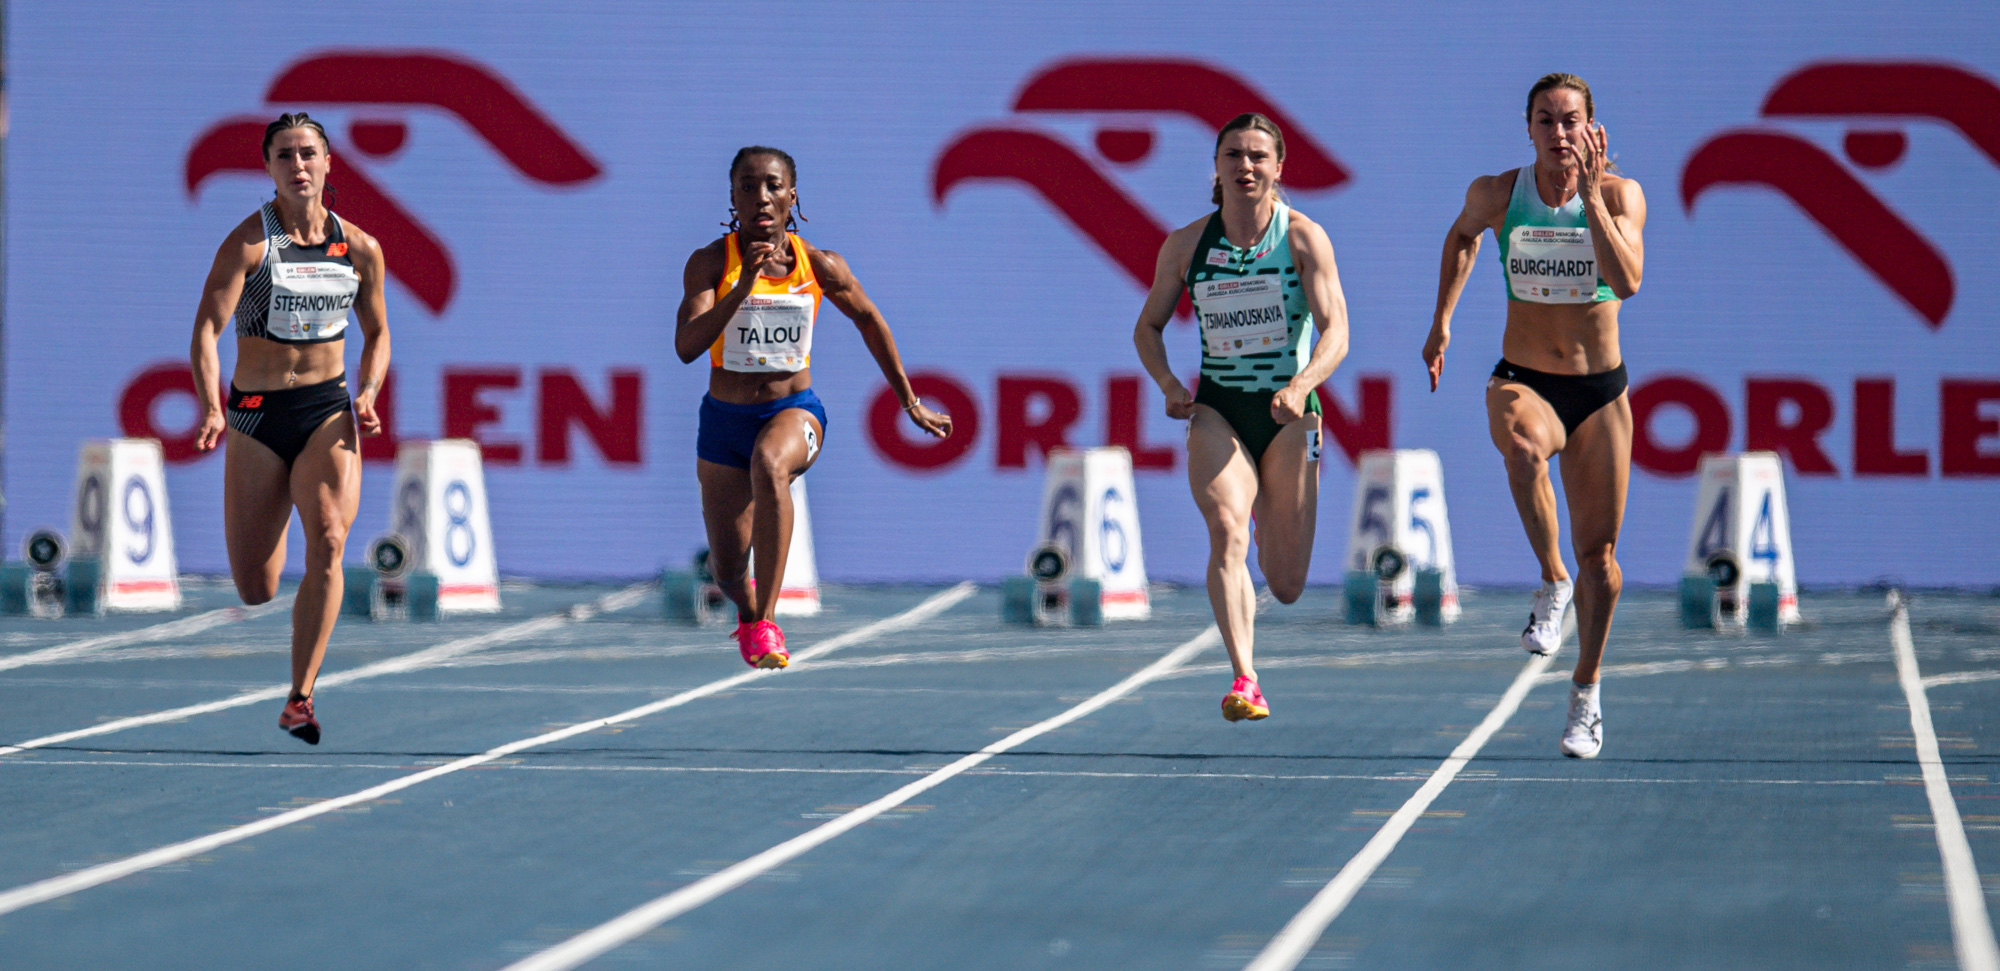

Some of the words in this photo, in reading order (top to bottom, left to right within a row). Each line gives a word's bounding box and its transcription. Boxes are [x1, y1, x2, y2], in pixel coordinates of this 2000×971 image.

[1510, 258, 1594, 277] BURGHARDT
[274, 292, 353, 311] STEFANOWICZ
[1204, 304, 1284, 330] TSIMANOUSKAYA
[737, 326, 761, 345] TA
[764, 326, 801, 344] LOU
[124, 474, 155, 565] 9
[443, 479, 477, 567] 8
[1099, 486, 1127, 573] 6
[1750, 488, 1780, 562] 4
